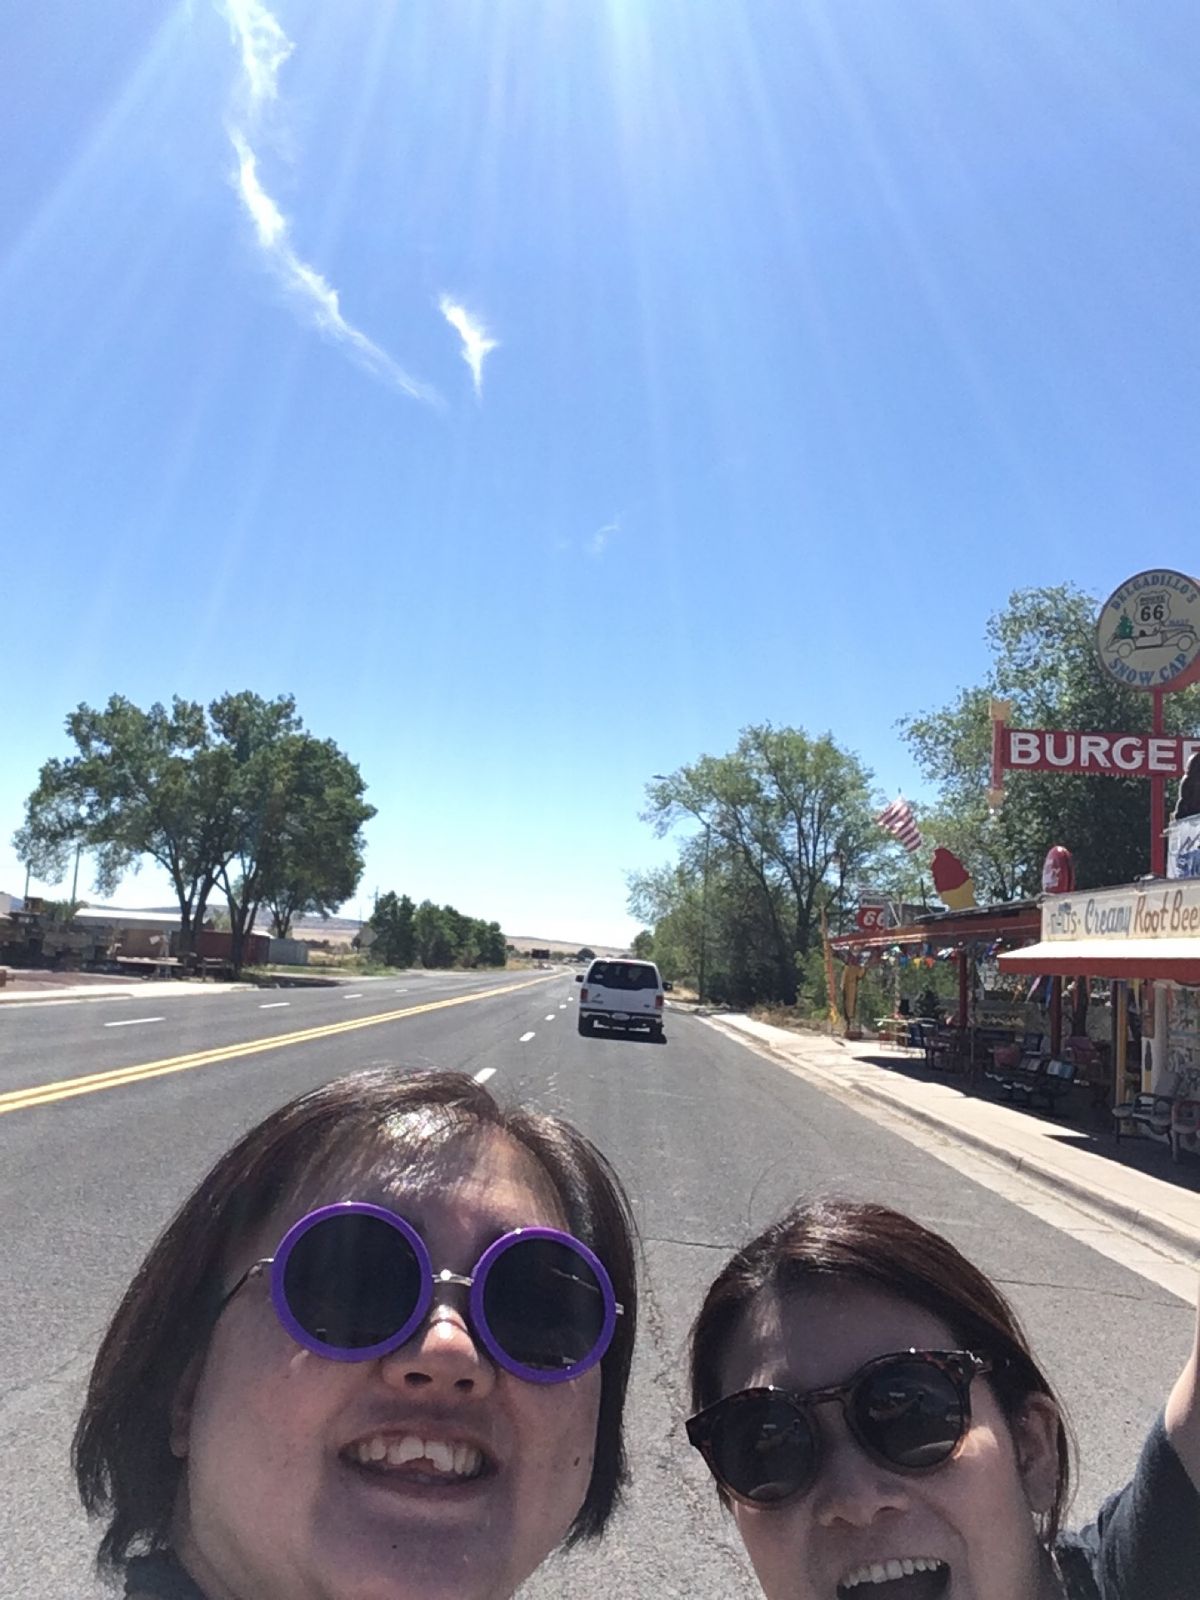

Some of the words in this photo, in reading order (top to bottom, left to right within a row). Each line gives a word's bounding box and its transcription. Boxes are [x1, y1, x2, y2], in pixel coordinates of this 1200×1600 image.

[1110, 575, 1198, 611] DELGADILLO'S
[1140, 604, 1164, 622] 66
[1108, 657, 1154, 684] SNOW
[1159, 653, 1187, 682] CAP
[1084, 898, 1132, 936] Creamy
[1133, 891, 1169, 934] Root
[1170, 889, 1200, 932] Bee
